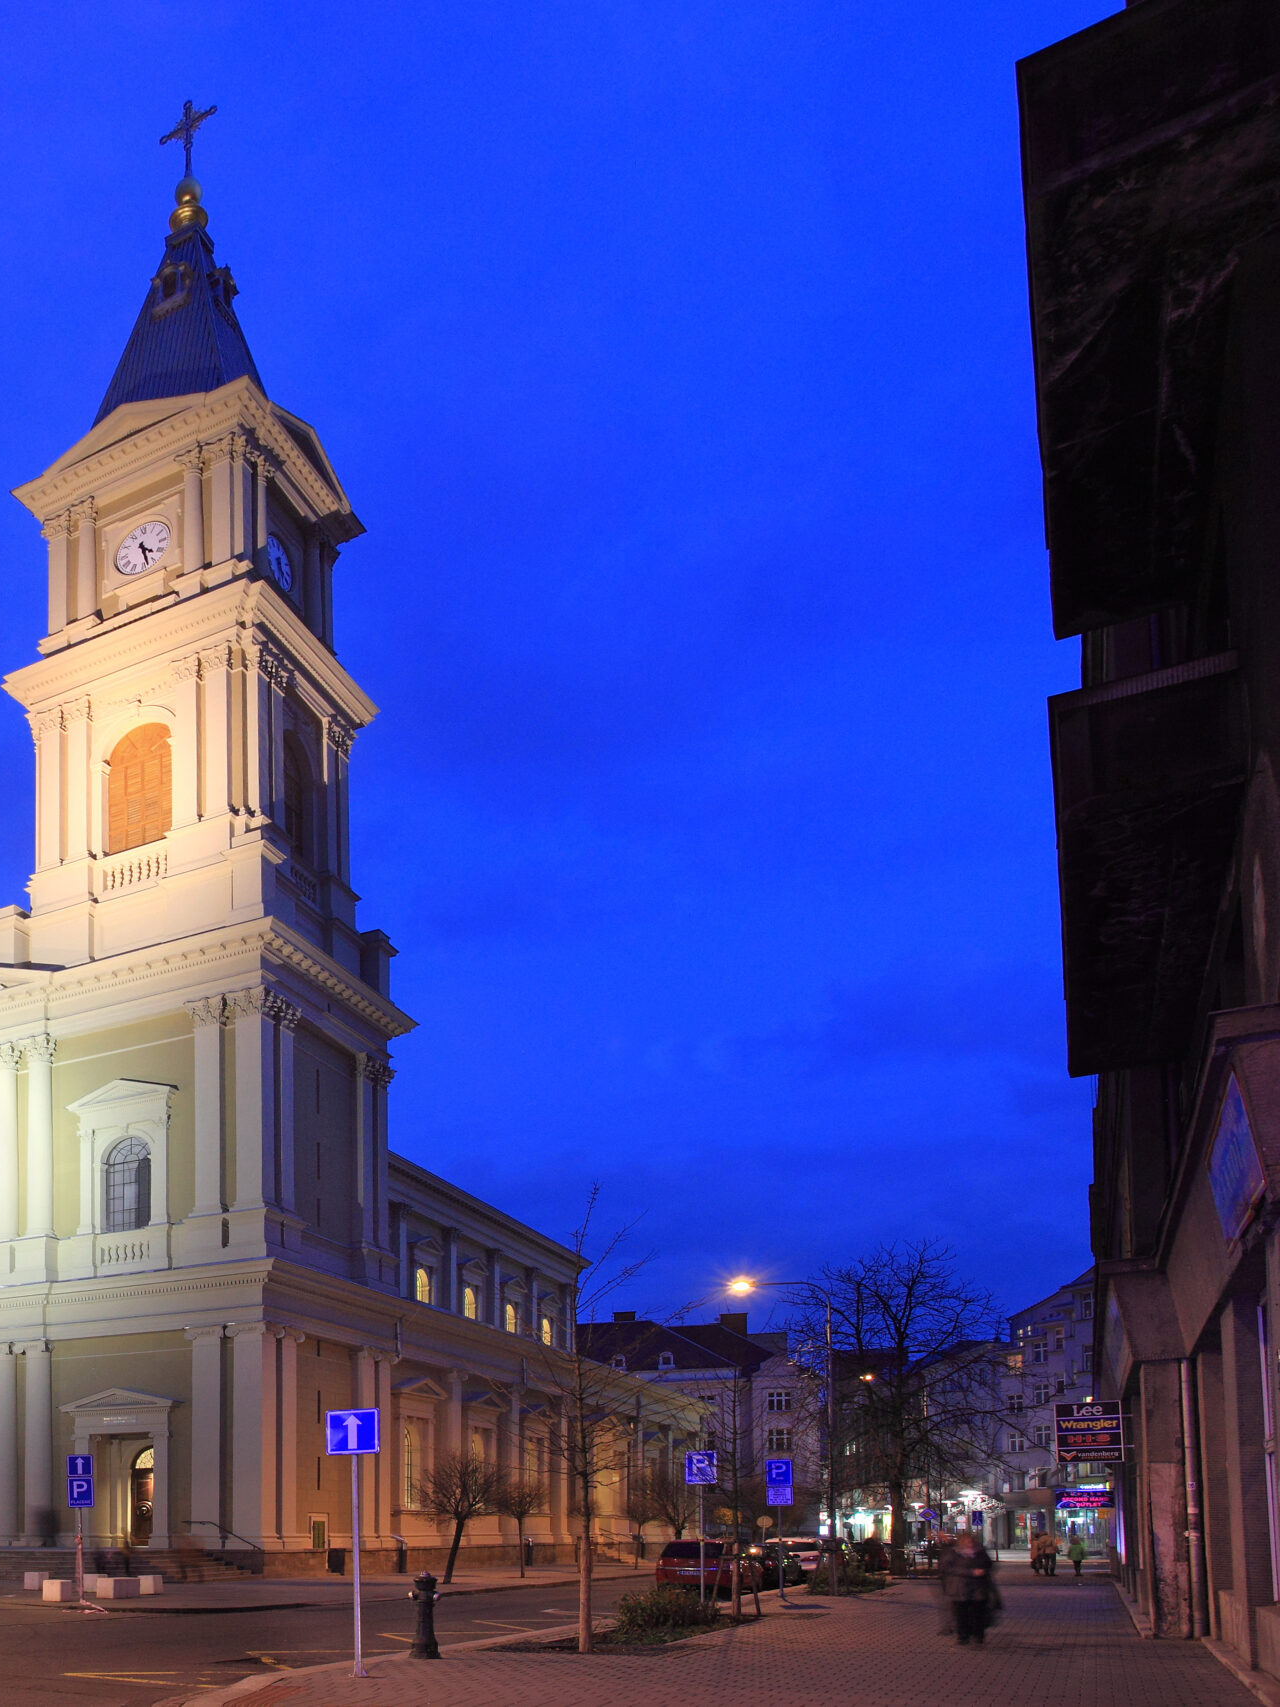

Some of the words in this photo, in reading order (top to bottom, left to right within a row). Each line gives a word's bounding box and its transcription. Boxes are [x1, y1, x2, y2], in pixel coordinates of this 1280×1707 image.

[1072, 1405, 1102, 1416] Lee
[1060, 1420, 1118, 1430] Wrangler
[772, 1464, 786, 1478] P
[73, 1481, 88, 1498] P
